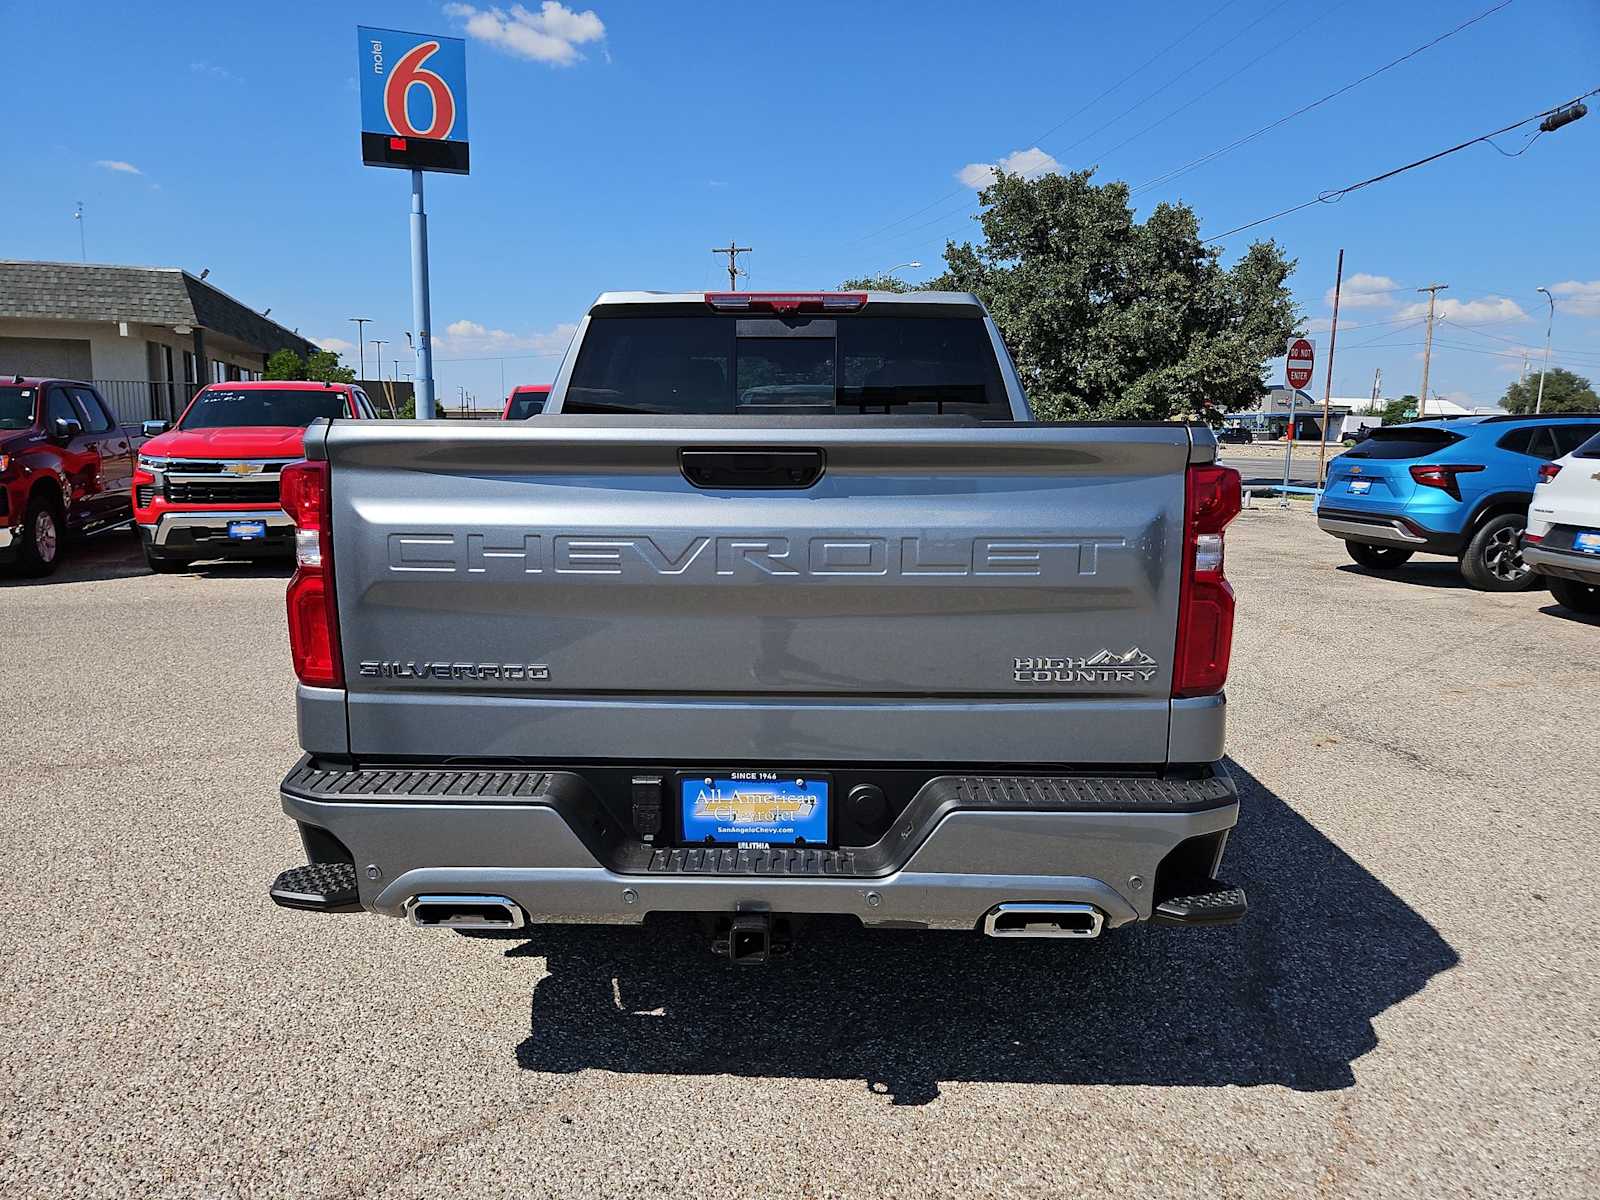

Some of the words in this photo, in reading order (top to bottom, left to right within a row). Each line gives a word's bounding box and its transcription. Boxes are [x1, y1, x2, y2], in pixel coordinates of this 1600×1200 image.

[371, 40, 383, 74] motel
[384, 40, 456, 140] 6
[1290, 349, 1298, 357] DO
[1300, 349, 1311, 357] NOT
[1291, 371, 1308, 380] ENTER
[387, 532, 1127, 577] CHEVROLET
[1014, 657, 1087, 669] HIGH
[359, 661, 550, 680] SILVERADO
[1014, 670, 1157, 682] COUNTRY
[731, 772, 757, 780] SINCE
[695, 789, 721, 804] All
[731, 789, 817, 804] American
[714, 804, 796, 822] Chevrolet
[717, 826, 794, 834] SanAngeloChevy.com
